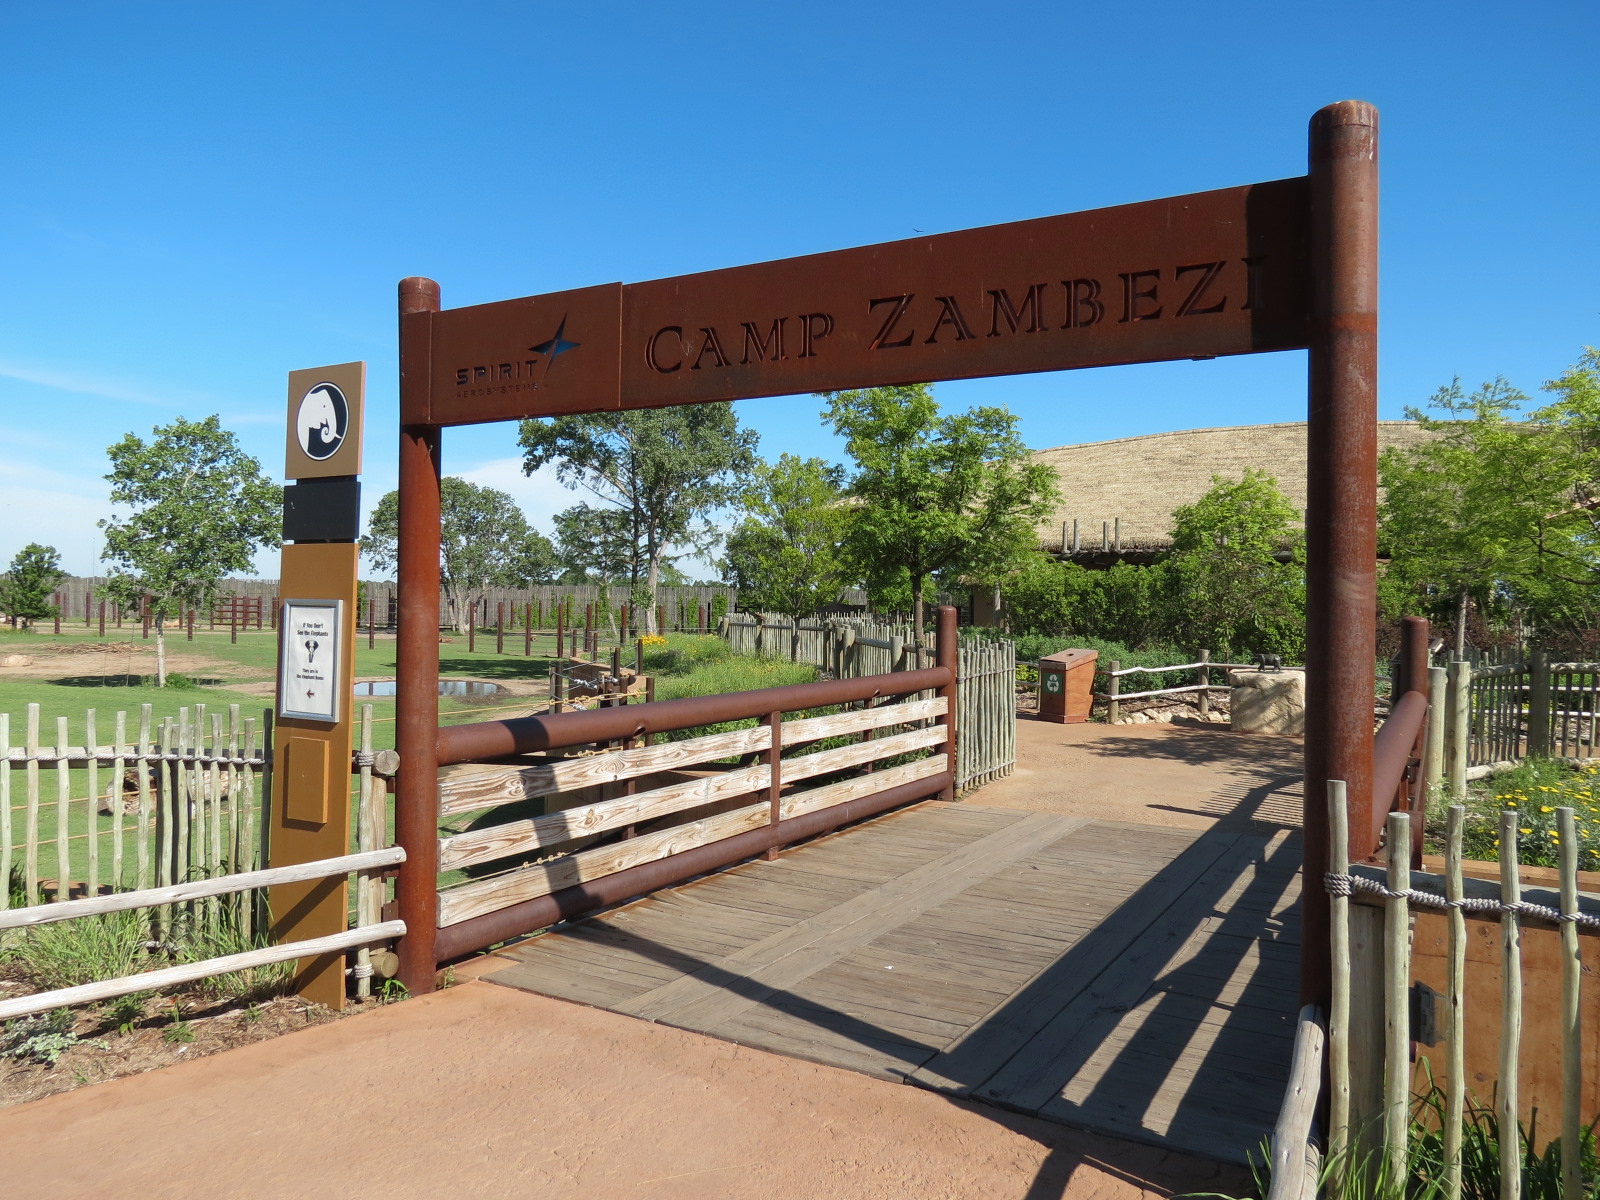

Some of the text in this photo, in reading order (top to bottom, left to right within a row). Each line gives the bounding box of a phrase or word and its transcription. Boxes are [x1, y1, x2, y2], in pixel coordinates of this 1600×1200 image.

[645, 255, 1268, 374] CAMP ZAMBEZI
[456, 360, 538, 385] SPIRIT
